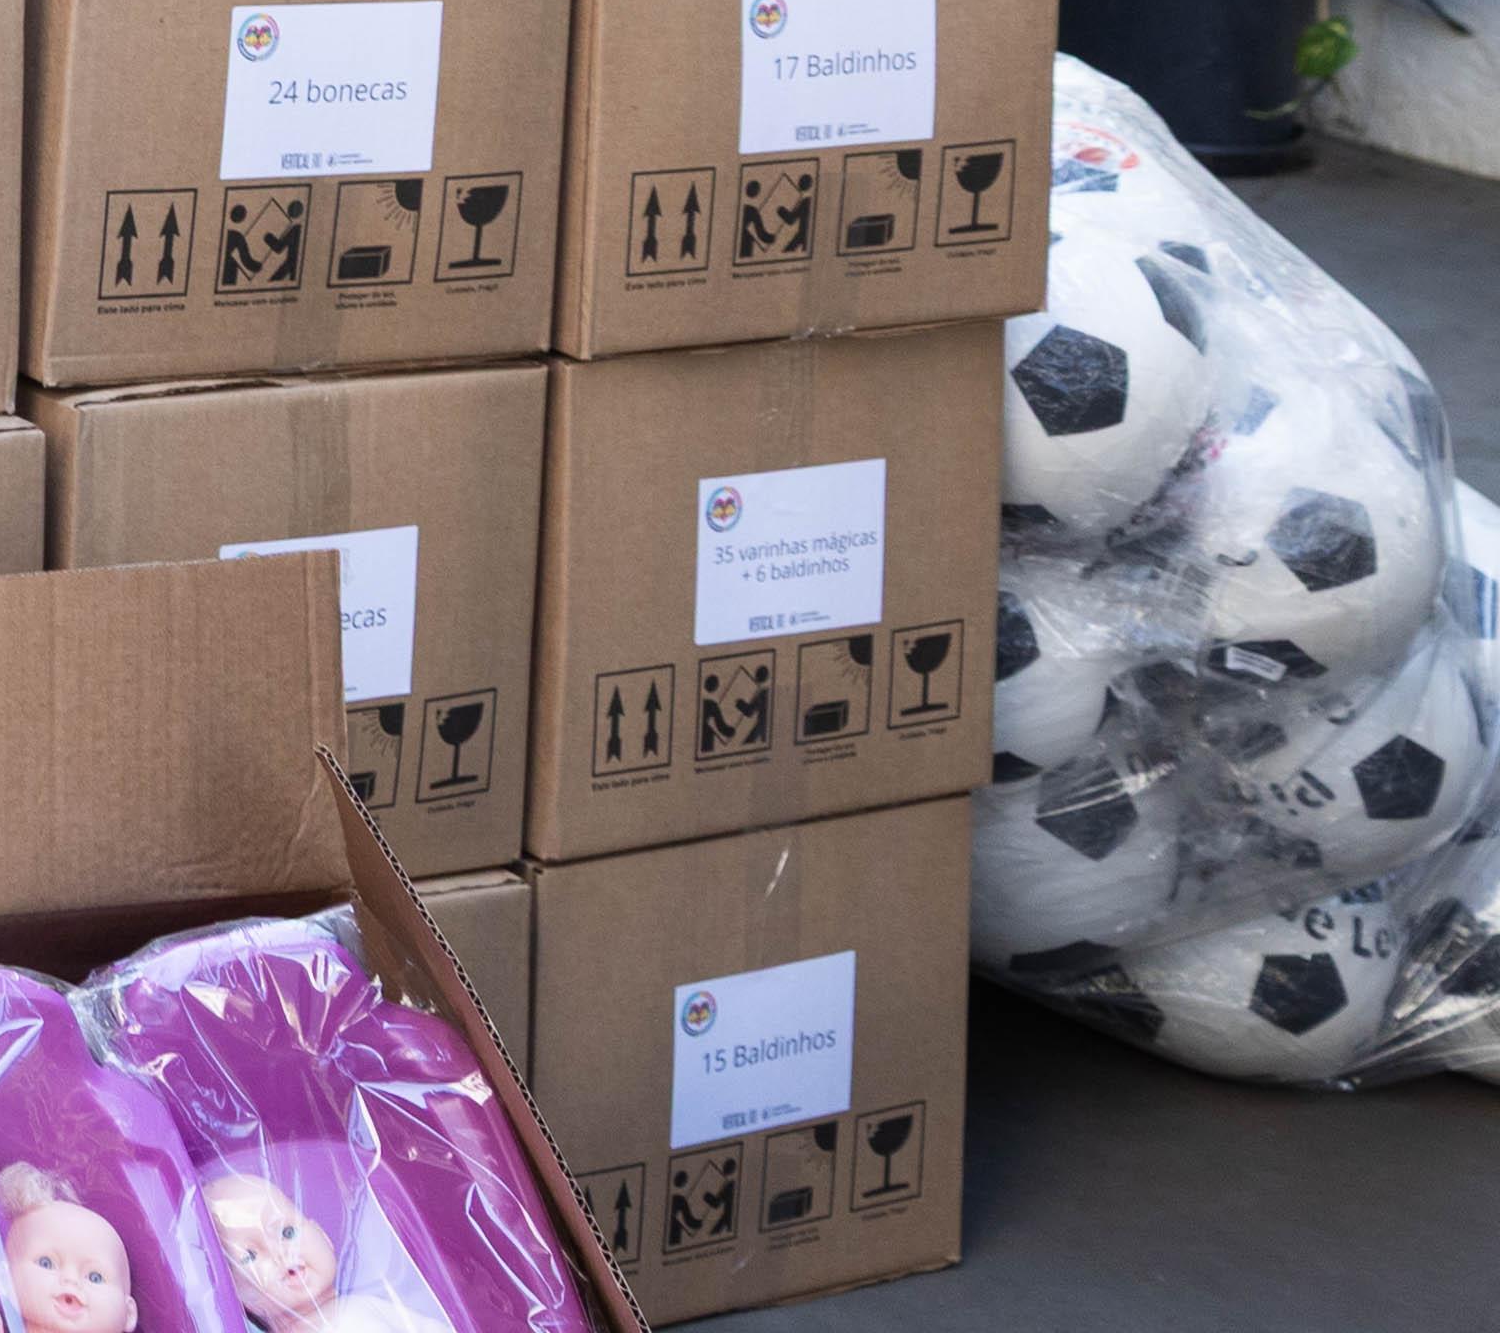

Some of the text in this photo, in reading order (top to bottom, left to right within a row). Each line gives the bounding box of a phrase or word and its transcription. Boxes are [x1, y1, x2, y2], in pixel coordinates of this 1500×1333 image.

[774, 48, 917, 80] 17 Baldinhos
[268, 78, 408, 105] 24 bonecas
[714, 530, 878, 565] 35 varinhas mágicas
[755, 564, 767, 583] 6
[770, 557, 851, 581] baldinhos
[701, 1029, 837, 1075] 15 Baldinhos
